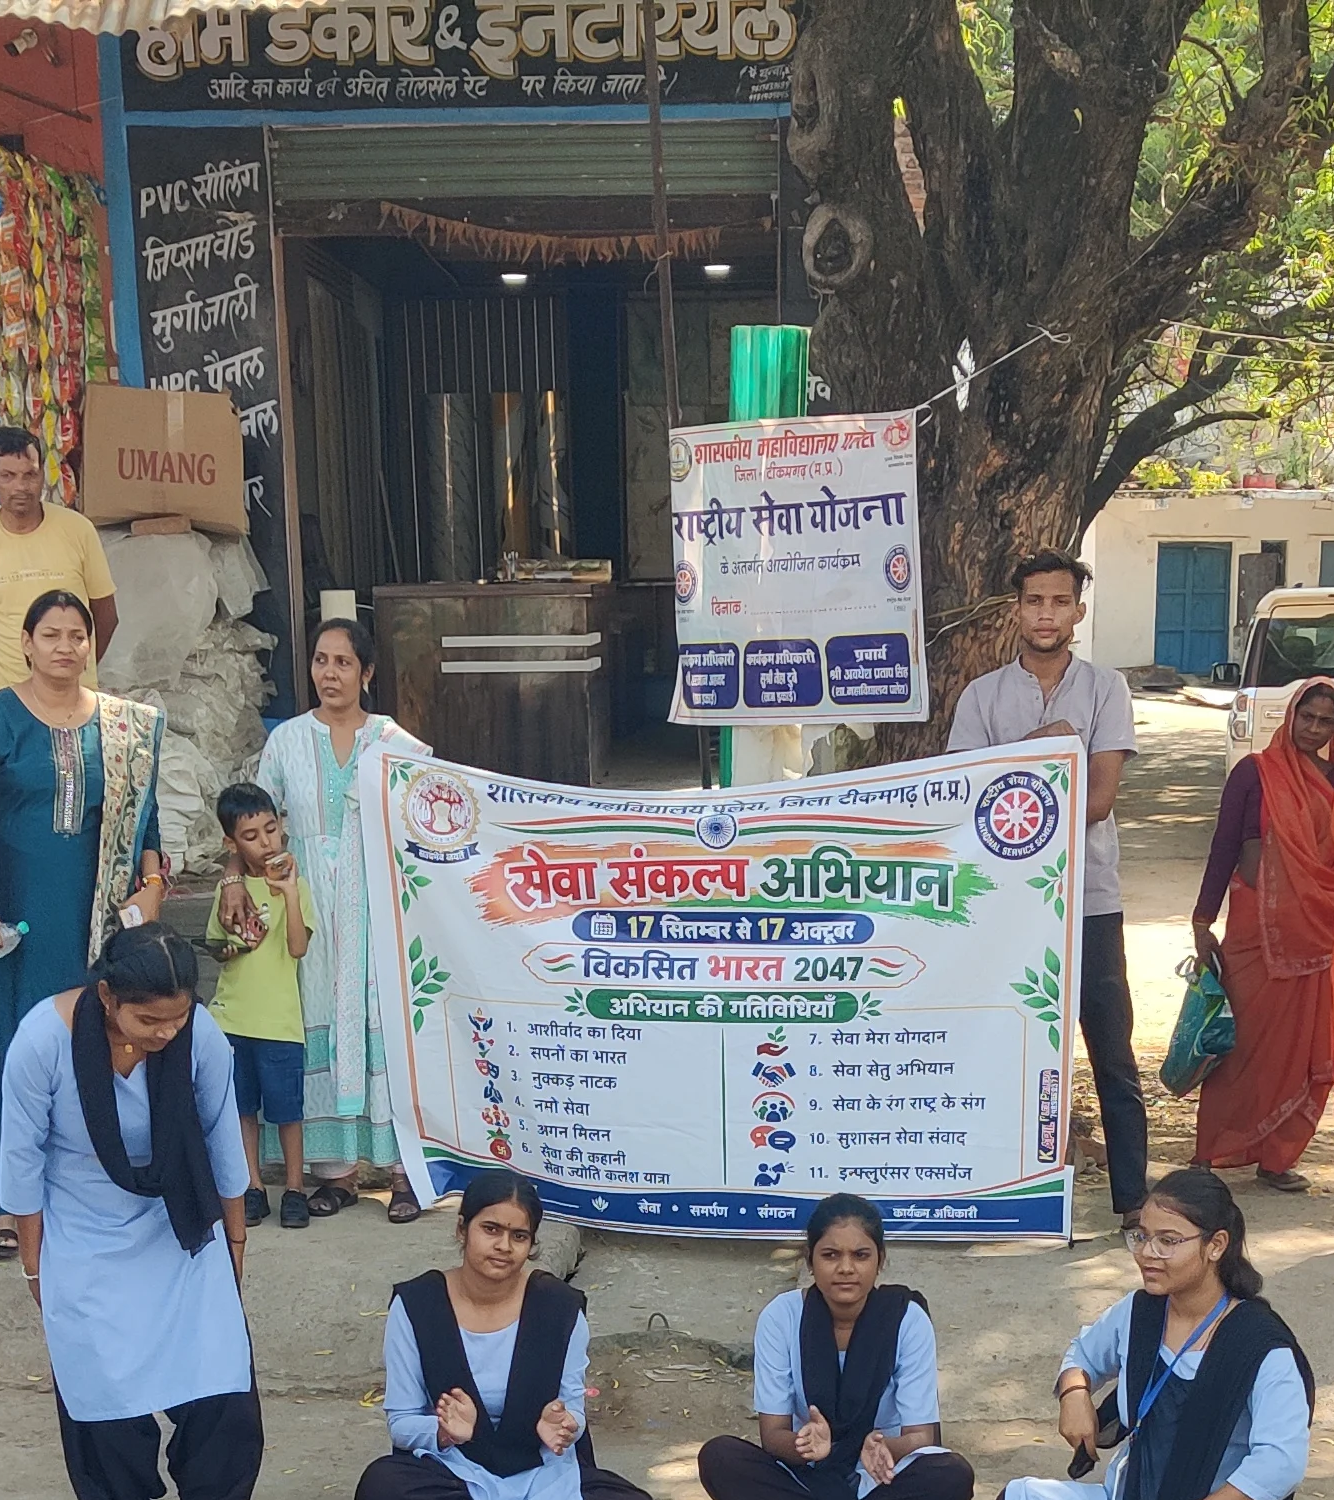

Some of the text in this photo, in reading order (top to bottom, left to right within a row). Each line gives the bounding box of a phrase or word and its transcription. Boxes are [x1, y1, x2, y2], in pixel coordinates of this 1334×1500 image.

[435, 5, 467, 50] &
[208, 71, 249, 102] आदि
[251, 78, 272, 98] का
[276, 68, 312, 97] कार्य
[344, 68, 390, 101] उचित
[463, 67, 490, 99] रेट
[521, 74, 546, 98] पर
[553, 67, 597, 97] किया
[602, 73, 645, 100] जाता
[139, 159, 263, 219] PVC सीलिंग
[200, 272, 260, 339] जाली
[203, 346, 265, 392] पैनल
[694, 430, 839, 465] शासकीय महाविद्यालय
[118, 448, 216, 488] UMANG
[734, 465, 757, 483] जिला
[673, 485, 908, 547] राष्ट्रीय सेवा योजना
[720, 556, 729, 576] के
[731, 555, 764, 576] अंतर्गत
[767, 551, 815, 573] आयोजित
[829, 665, 842, 681] श्री
[487, 775, 971, 816] शासकीय महाविद्यालय जिला टीकमगढ़ (म.प्र.)
[508, 845, 954, 908] सेवा संकल्प अभियान
[627, 915, 857, 945] 17 सितम्बर से 17 अक्टूबर
[581, 948, 864, 982] विकसित भारत 2047
[609, 993, 836, 1019] अभियान की गतिविधियाँ
[527, 1020, 642, 1041] आशीर्वाद का दिया
[831, 1027, 948, 1046] सेवा मेरा योगदान
[529, 1044, 627, 1065] सपनों का भारत
[531, 1071, 618, 1091] नुक्कड़ नाटक
[832, 1058, 955, 1081] सेवा सेतु अभियान
[533, 1096, 590, 1116] नमो सेवा
[832, 1092, 986, 1114] सेवा के रंग राष्ट्र के संग
[572, 1123, 611, 1142] मिलन
[809, 1127, 968, 1149] 10. सुशासन सेवा संवाद
[540, 1142, 626, 1166] सेवा की कहानी
[543, 1158, 670, 1185] सेवा ज्योति कलश यात्रा
[809, 1166, 829, 1179] 11.
[637, 1198, 797, 1220] सेवा समर्पण संगठन
